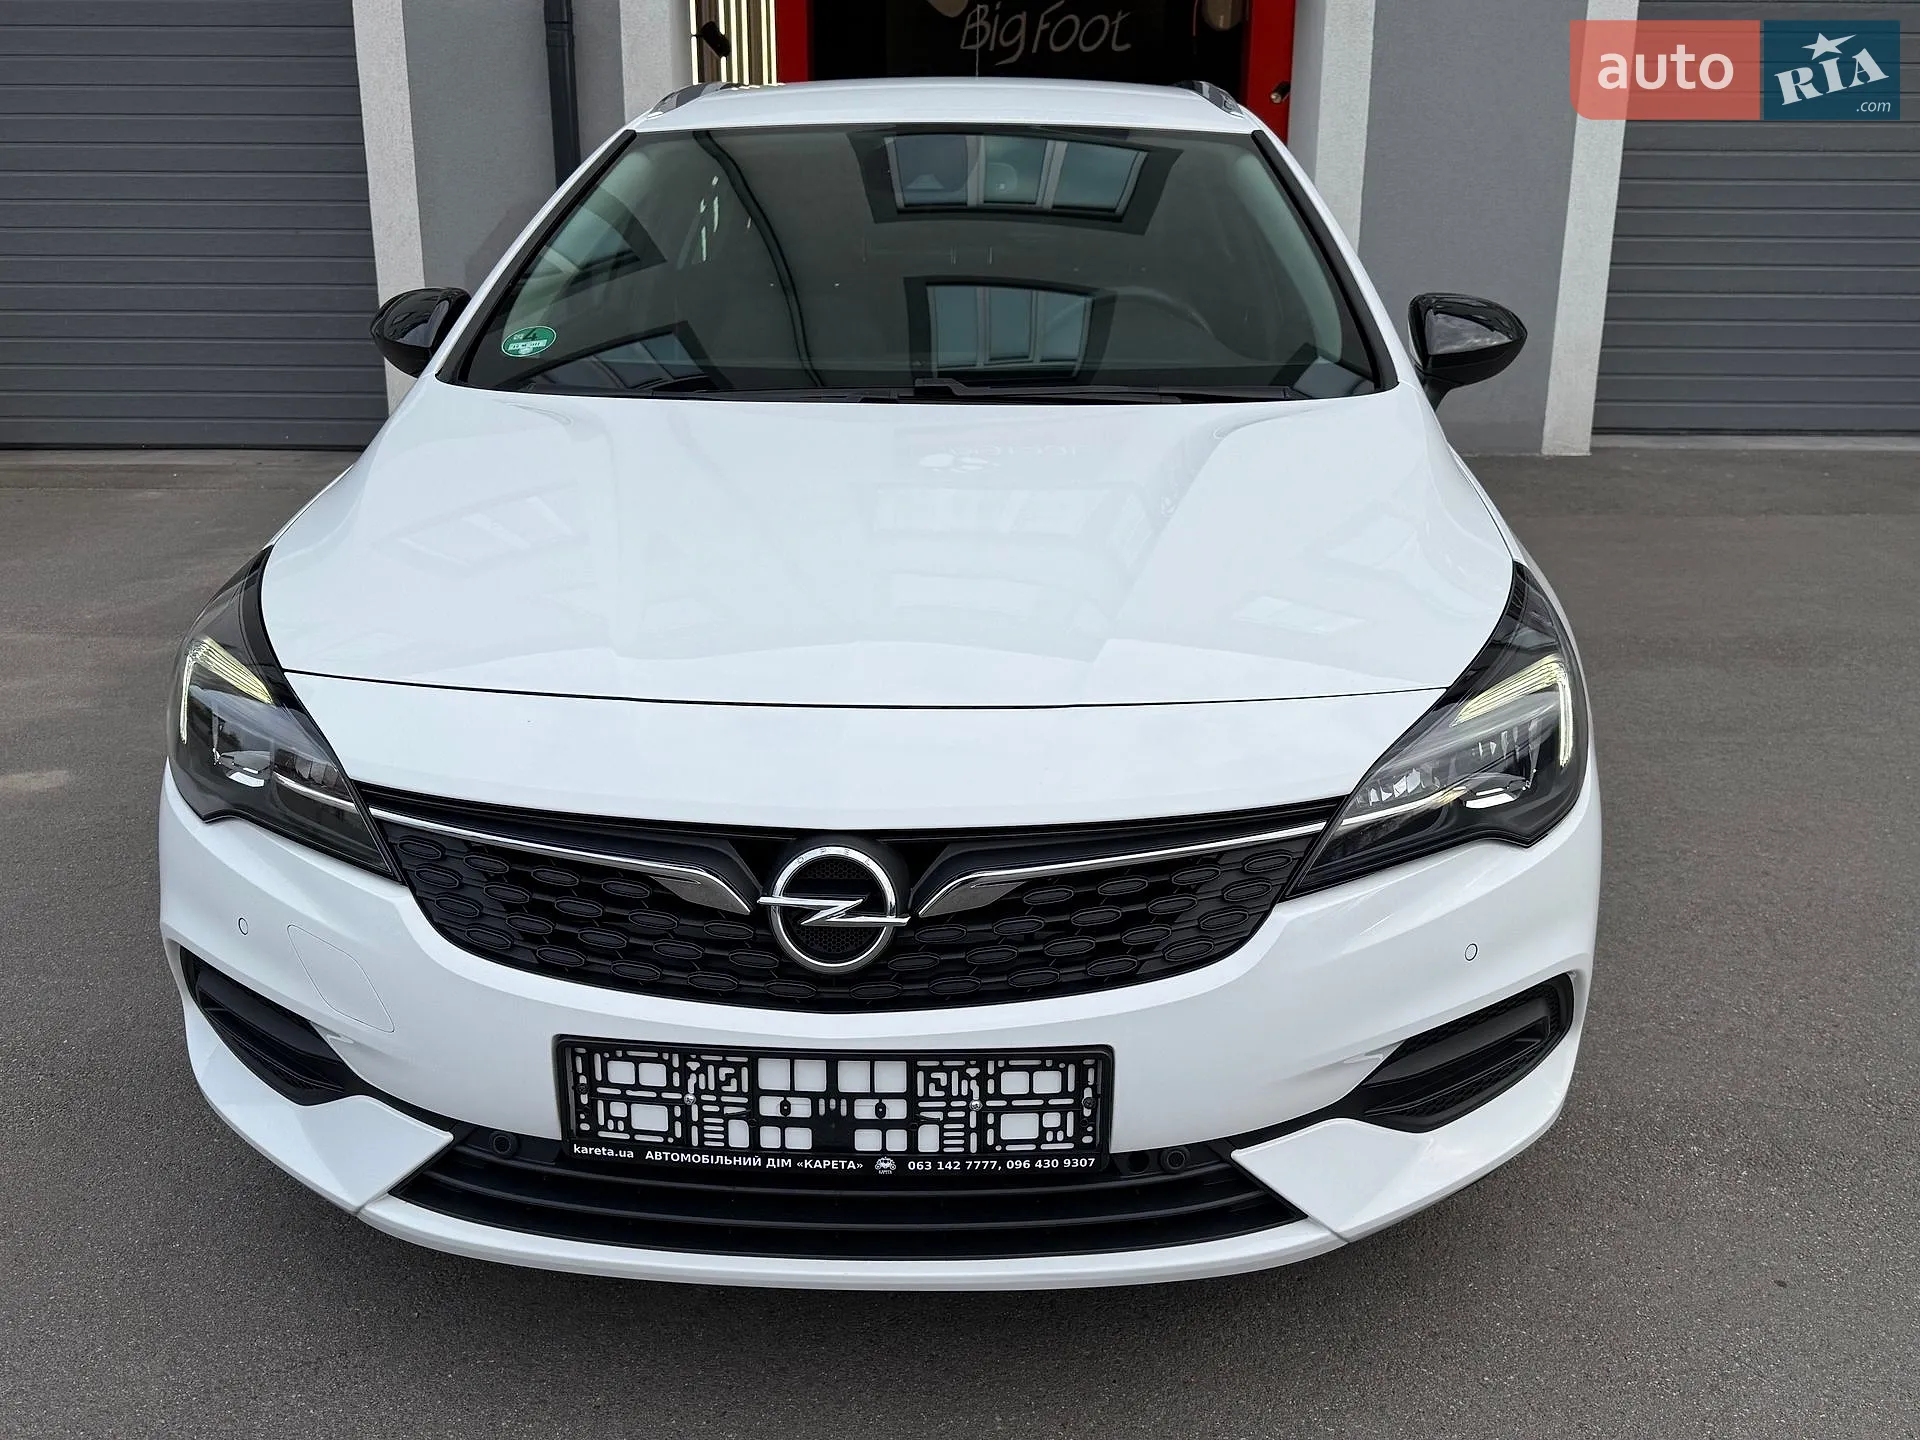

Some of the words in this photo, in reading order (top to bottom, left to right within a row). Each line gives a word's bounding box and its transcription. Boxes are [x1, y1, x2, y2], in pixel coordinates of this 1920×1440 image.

[797, 847, 871, 866] OPEL
[573, 1144, 634, 1158] kareta.ua
[645, 1150, 762, 1167] АВТОМОБІЛЬНИЙ
[766, 1158, 792, 1169] ДІМ
[796, 1159, 864, 1170] «КАРЕТА»
[908, 1161, 932, 1170] 063
[937, 1161, 961, 1170] 142
[965, 1160, 1002, 1171] 7777,
[1006, 1160, 1031, 1170] 096
[1035, 1159, 1059, 1169] 430
[1063, 1158, 1096, 1168] 9307
